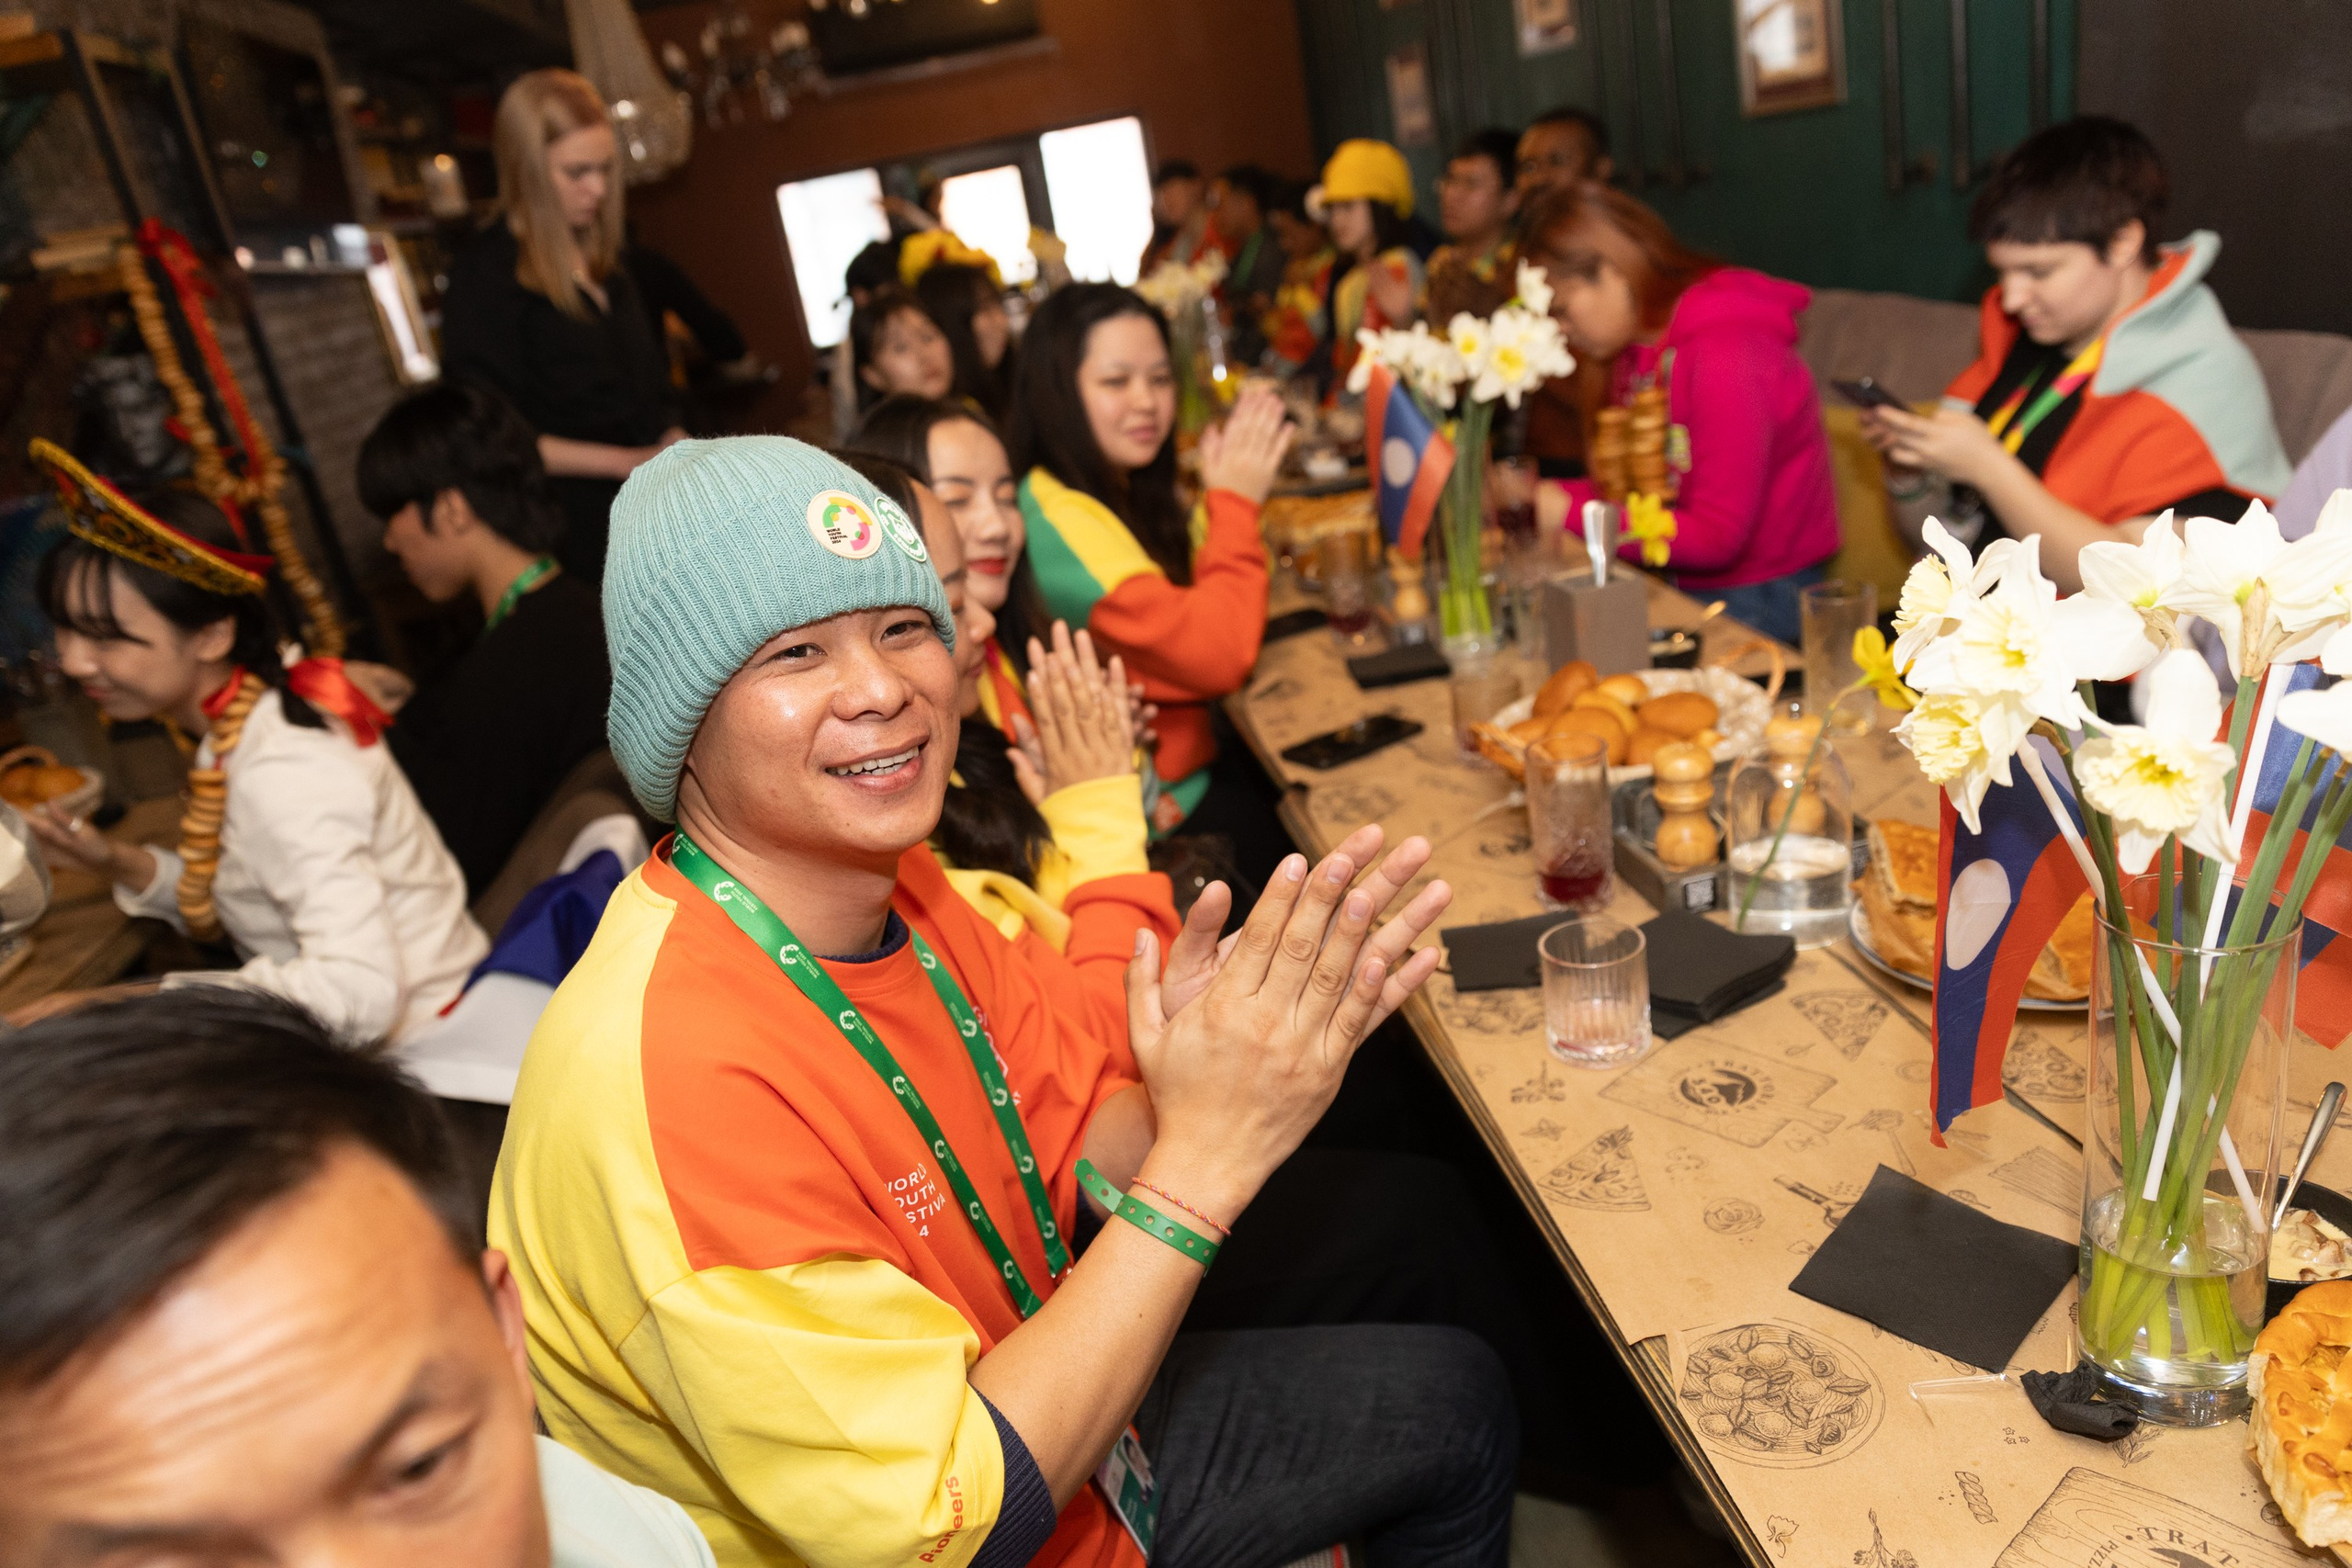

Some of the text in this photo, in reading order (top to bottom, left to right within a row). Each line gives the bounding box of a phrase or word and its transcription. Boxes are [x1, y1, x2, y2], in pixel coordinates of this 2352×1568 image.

[894, 1179, 936, 1208] OUTH
[905, 1192, 946, 1224] STIVA
[918, 1476, 964, 1563] Pioneers
[2087, 1540, 2119, 1568] PIZZ
